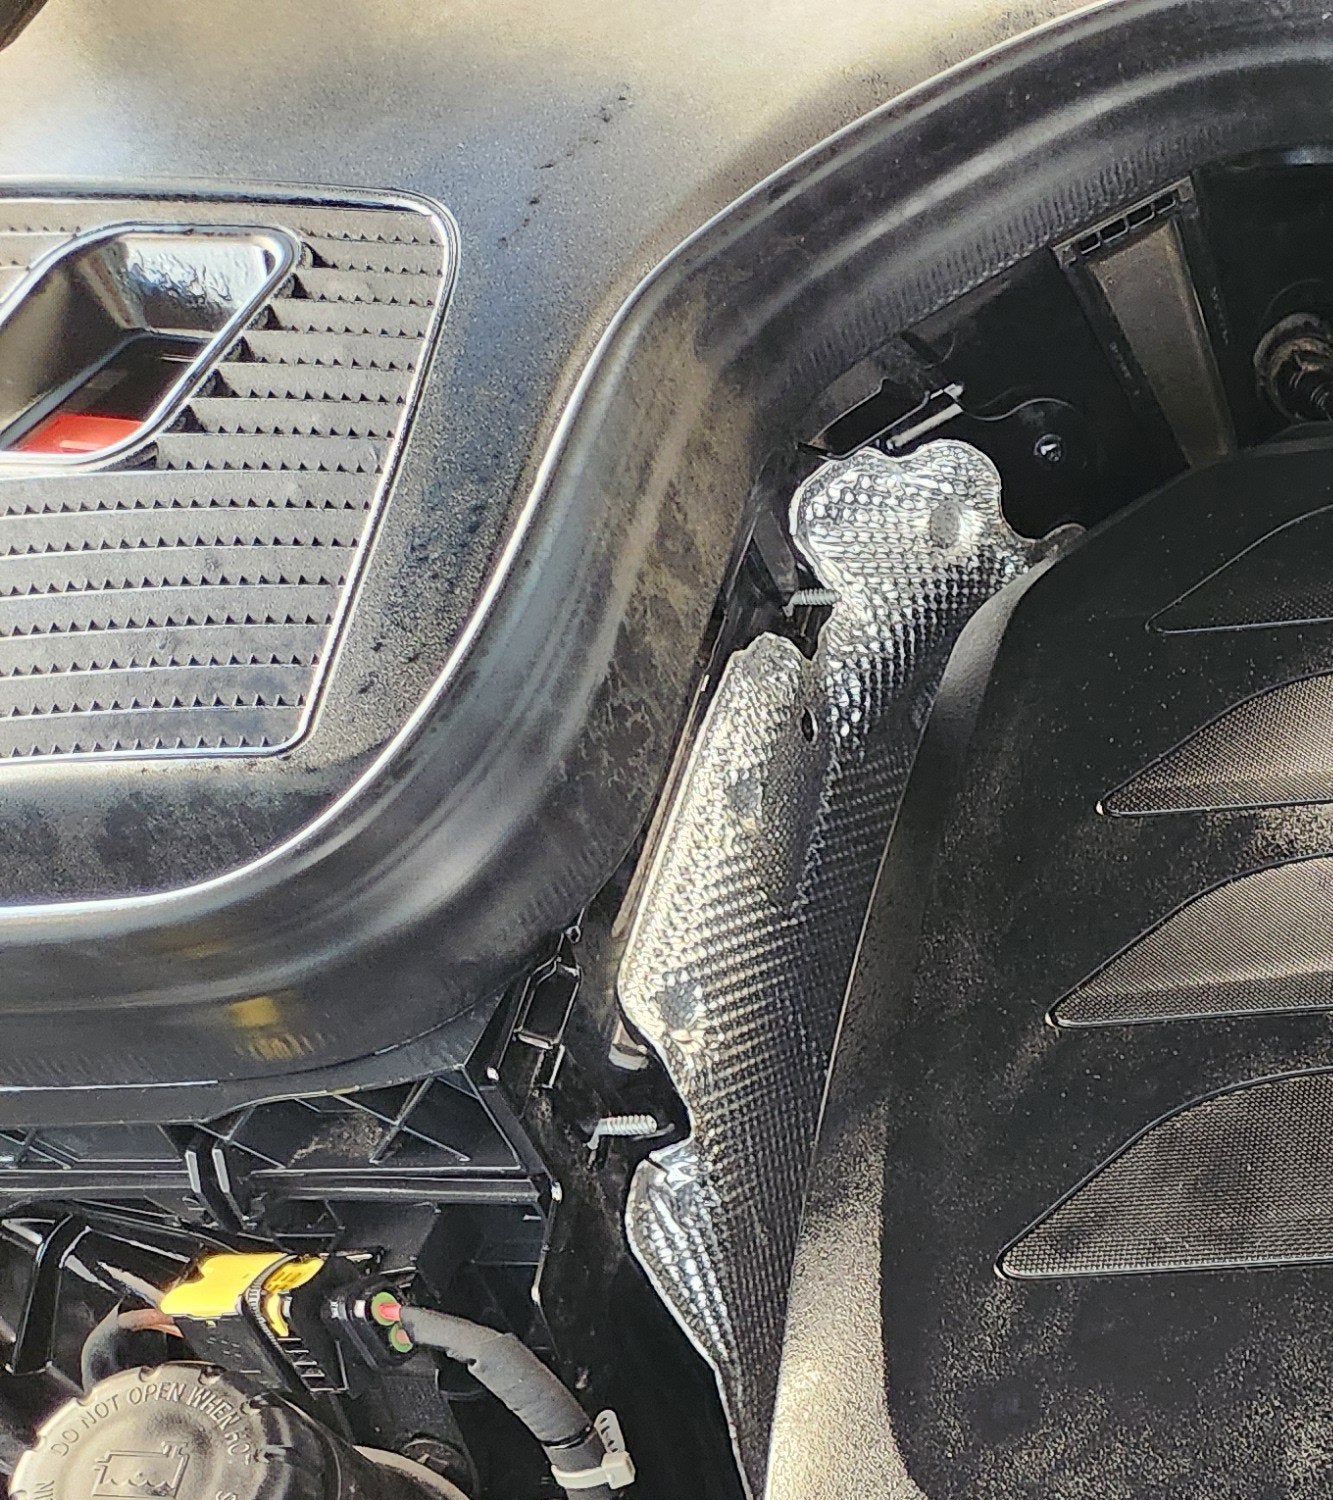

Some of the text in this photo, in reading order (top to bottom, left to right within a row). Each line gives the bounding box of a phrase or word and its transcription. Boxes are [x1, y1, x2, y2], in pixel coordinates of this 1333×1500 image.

[50, 1428, 80, 1457] DO
[81, 1394, 120, 1430] NOT
[128, 1381, 186, 1406] OPEN
[186, 1386, 242, 1430] WHEN
